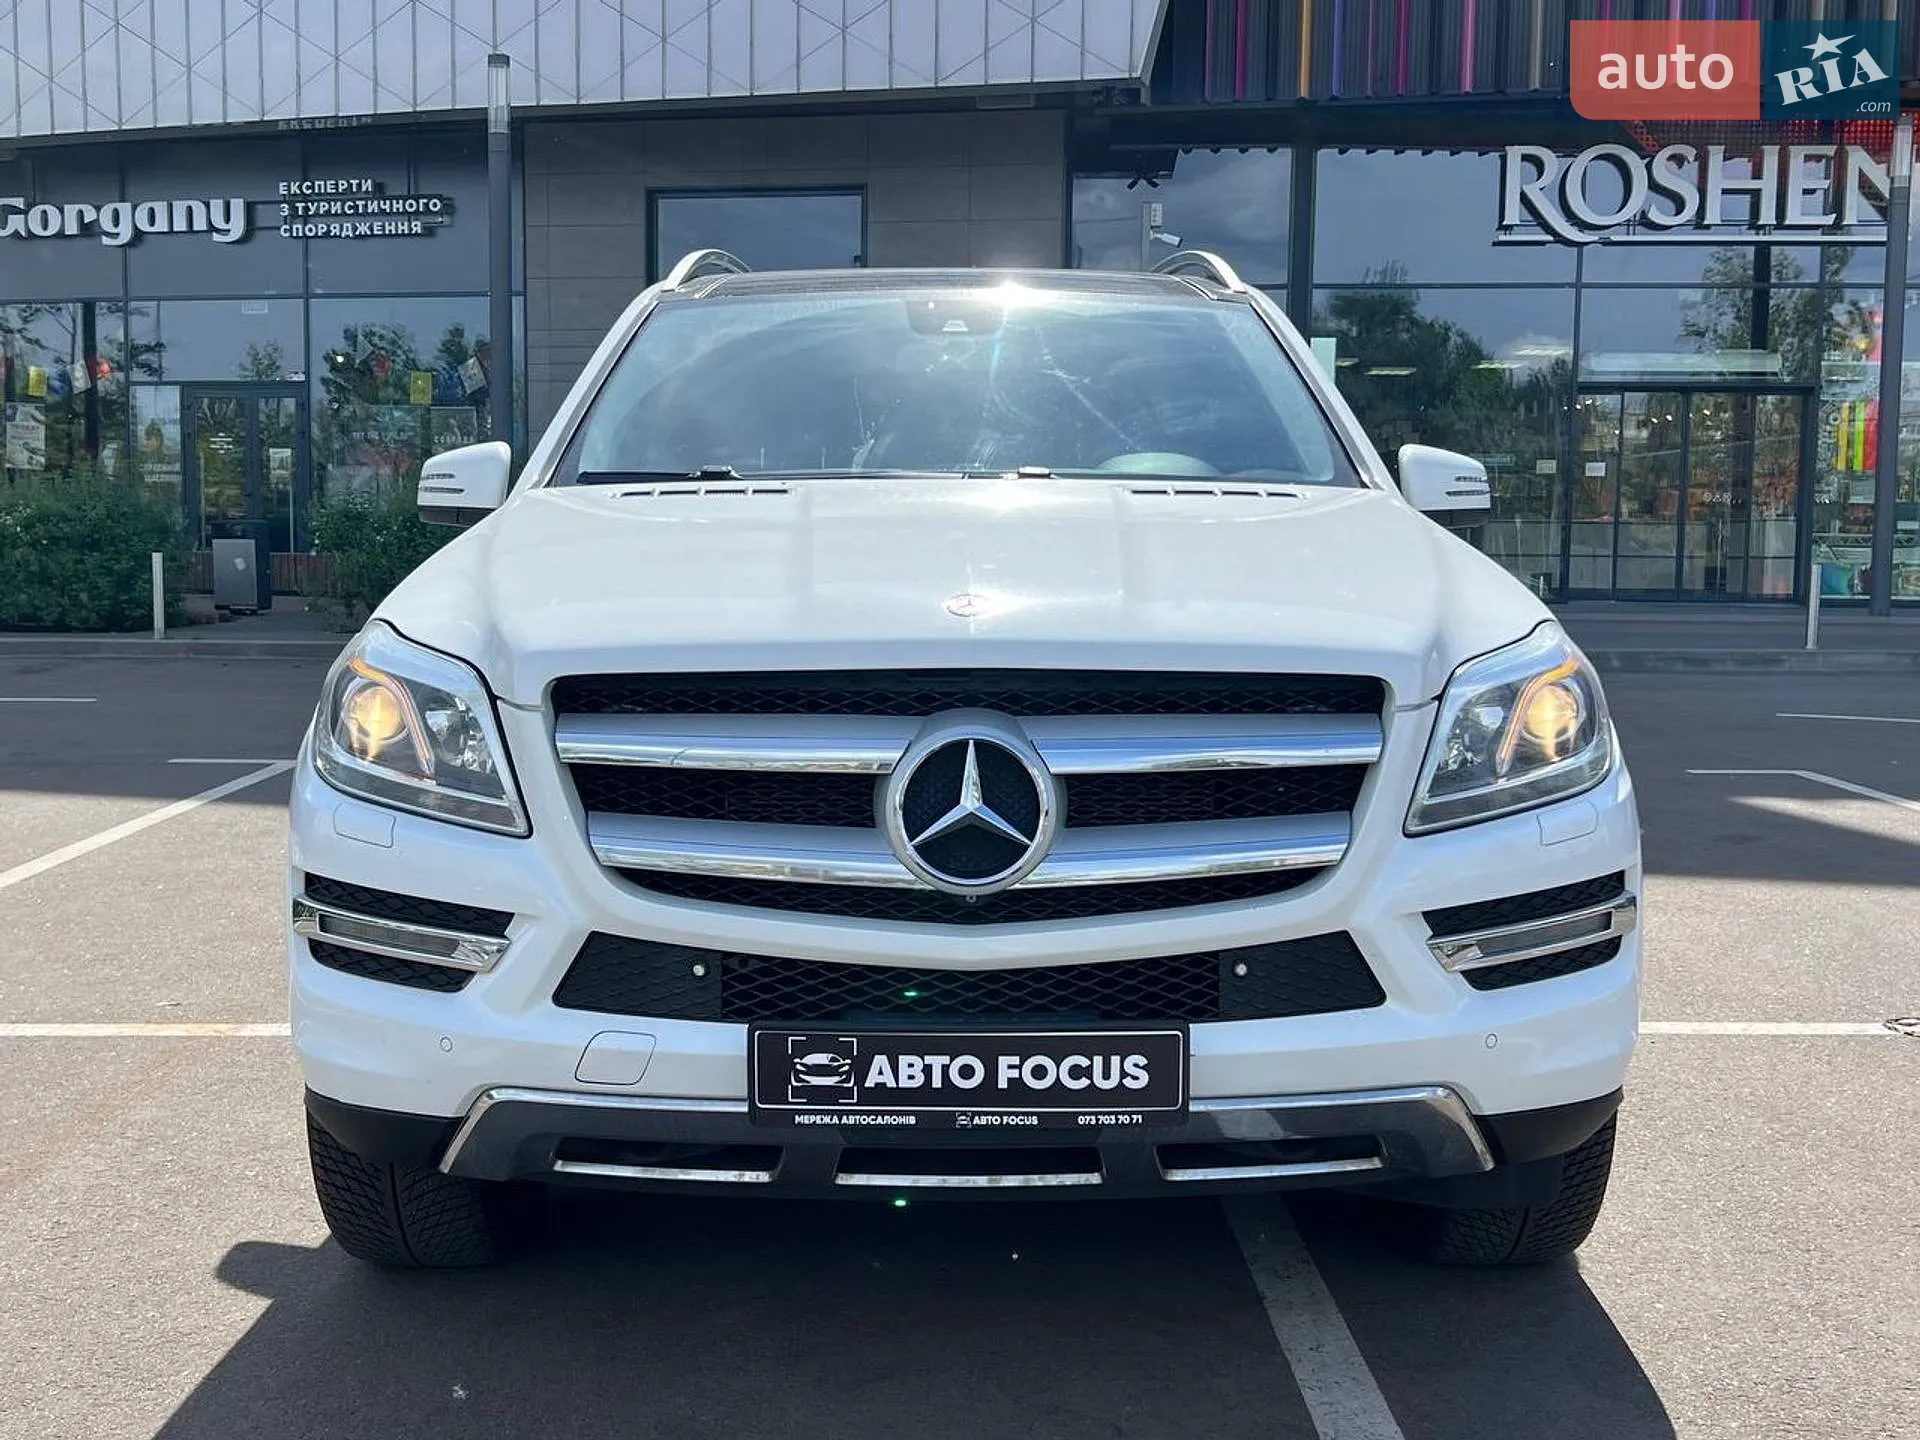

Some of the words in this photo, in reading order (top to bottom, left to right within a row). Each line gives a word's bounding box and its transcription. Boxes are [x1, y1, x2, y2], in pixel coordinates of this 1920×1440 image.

[278, 179, 373, 195] ЕКСПЕРТИ
[294, 198, 443, 216] ТУРИСТИЧНОГО
[0, 197, 246, 246] Gorgany
[280, 220, 423, 238] СПОРЯДЖЕННЯ
[864, 1054, 986, 1089] АВТО
[997, 1054, 1150, 1090] FOCUS
[794, 1114, 840, 1125] МЕРЕЖА
[841, 1114, 917, 1125] АВТОСАЛОНІВ
[972, 1115, 1001, 1125] АВТО
[1002, 1115, 1039, 1125] FOCUS
[1077, 1114, 1097, 1125] 073
[1097, 1114, 1116, 1125] 703
[1117, 1114, 1131, 1125] 70
[1131, 1114, 1142, 1124] 71
